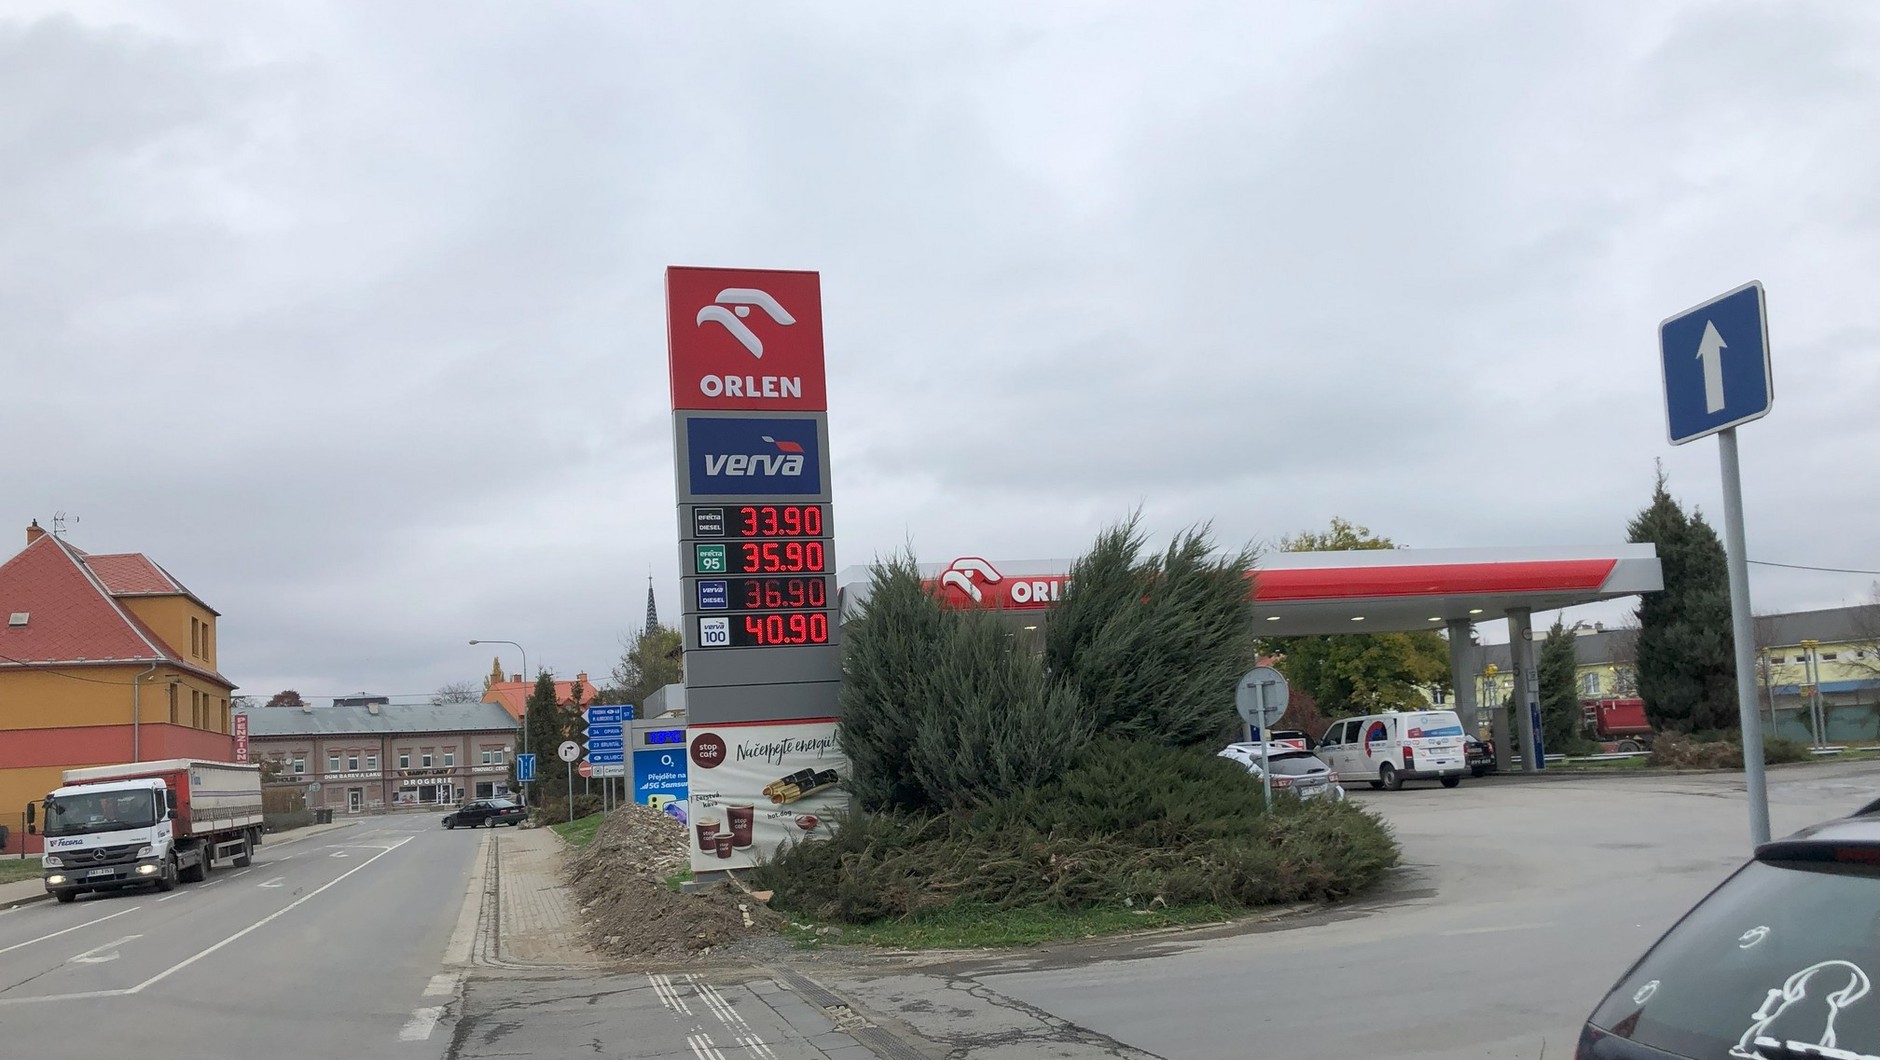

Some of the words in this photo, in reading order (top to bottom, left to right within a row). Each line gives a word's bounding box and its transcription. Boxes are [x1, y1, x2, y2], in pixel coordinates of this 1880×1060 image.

[700, 374, 802, 398] ORLEN
[704, 454, 804, 476] verva
[740, 506, 820, 536] 33.90
[703, 558, 720, 570] 95
[742, 542, 823, 572] 35.90
[744, 578, 825, 608] 36.90
[704, 631, 726, 643] 100
[746, 613, 827, 645] 40.90
[236, 716, 247, 760] PENZION
[737, 738, 795, 766] Načerpejte
[648, 772, 676, 781] Přejděte
